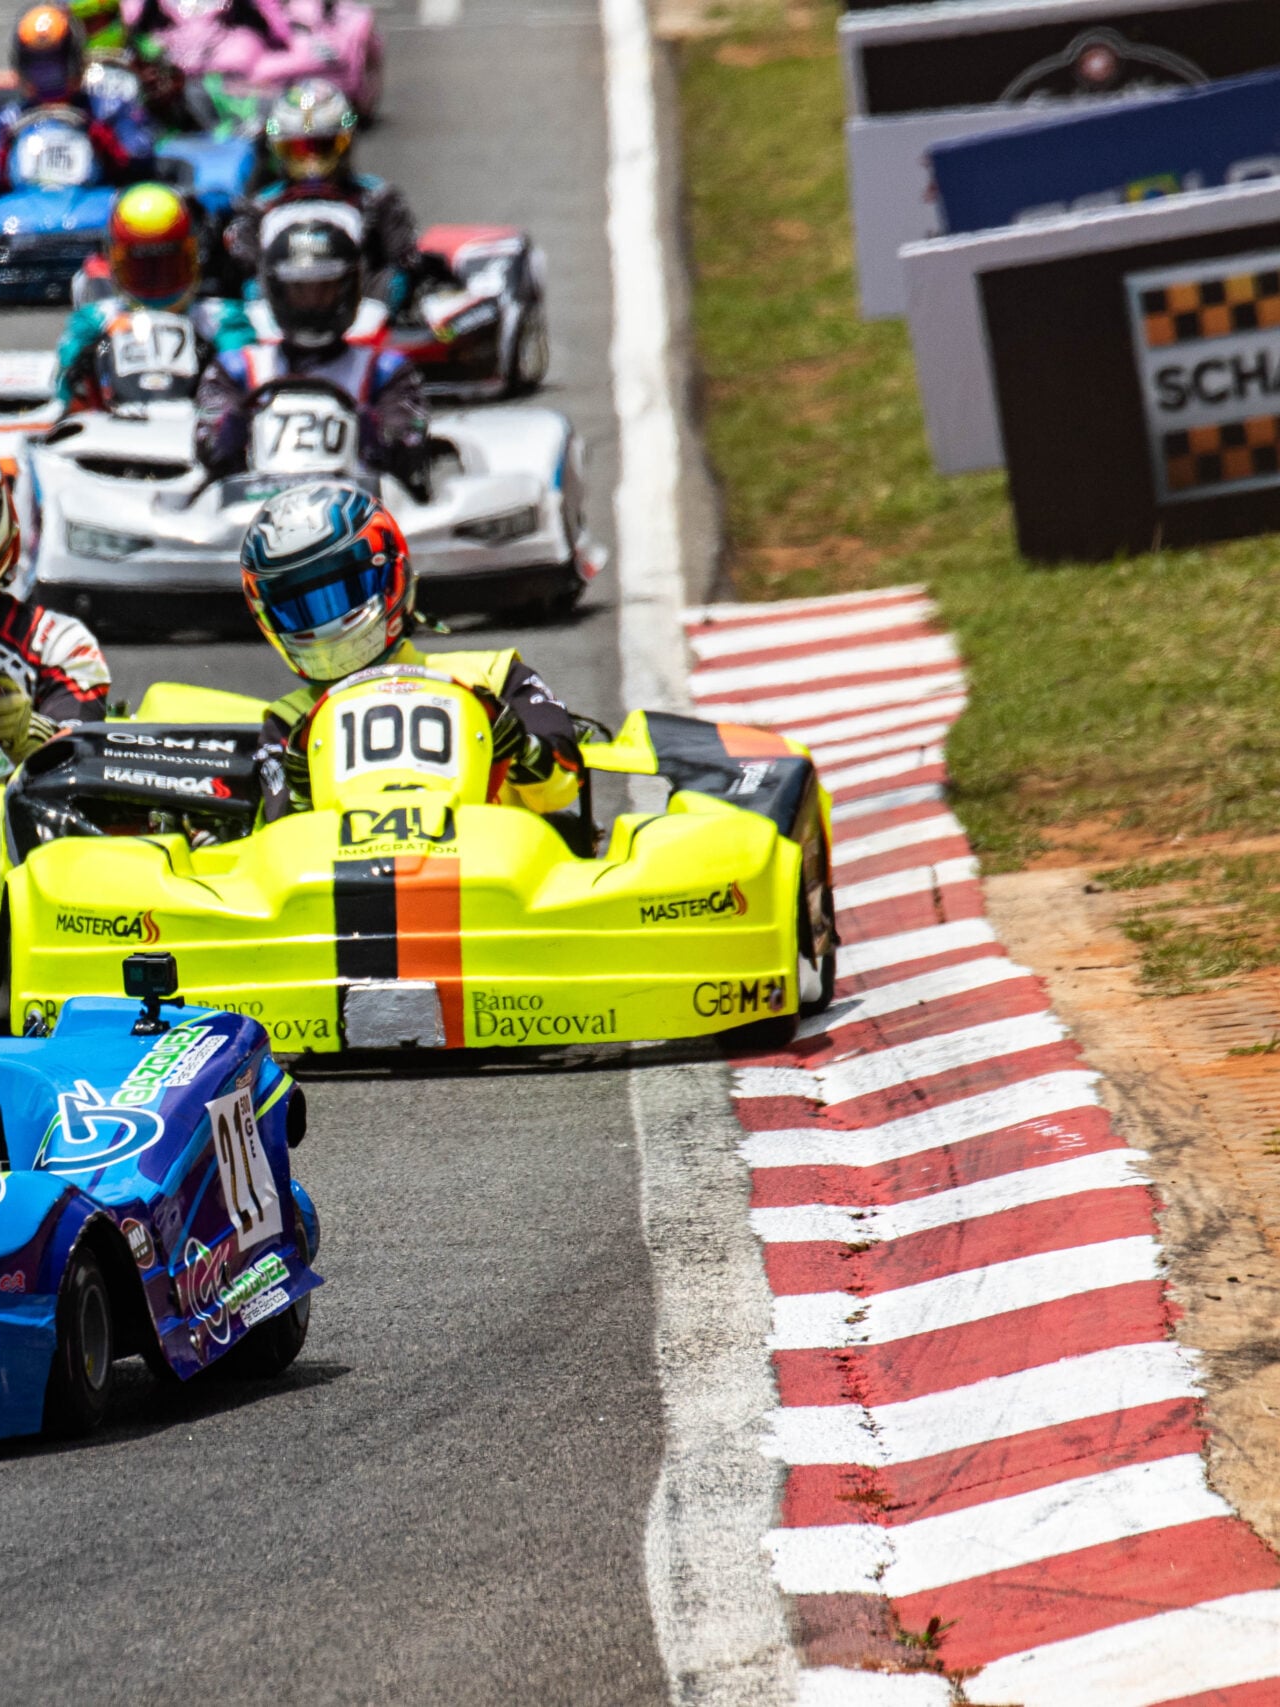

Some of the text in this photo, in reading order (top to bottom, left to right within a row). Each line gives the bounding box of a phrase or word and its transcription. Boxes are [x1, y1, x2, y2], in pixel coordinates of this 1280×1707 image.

[273, 411, 345, 453] 720
[342, 704, 452, 771] 100
[338, 841, 458, 856] IMMIGRATION
[472, 988, 544, 1012] Banco
[473, 1008, 617, 1043] Daycoval
[117, 1026, 207, 1105] GAZQUEZ
[218, 1099, 264, 1235] 21
